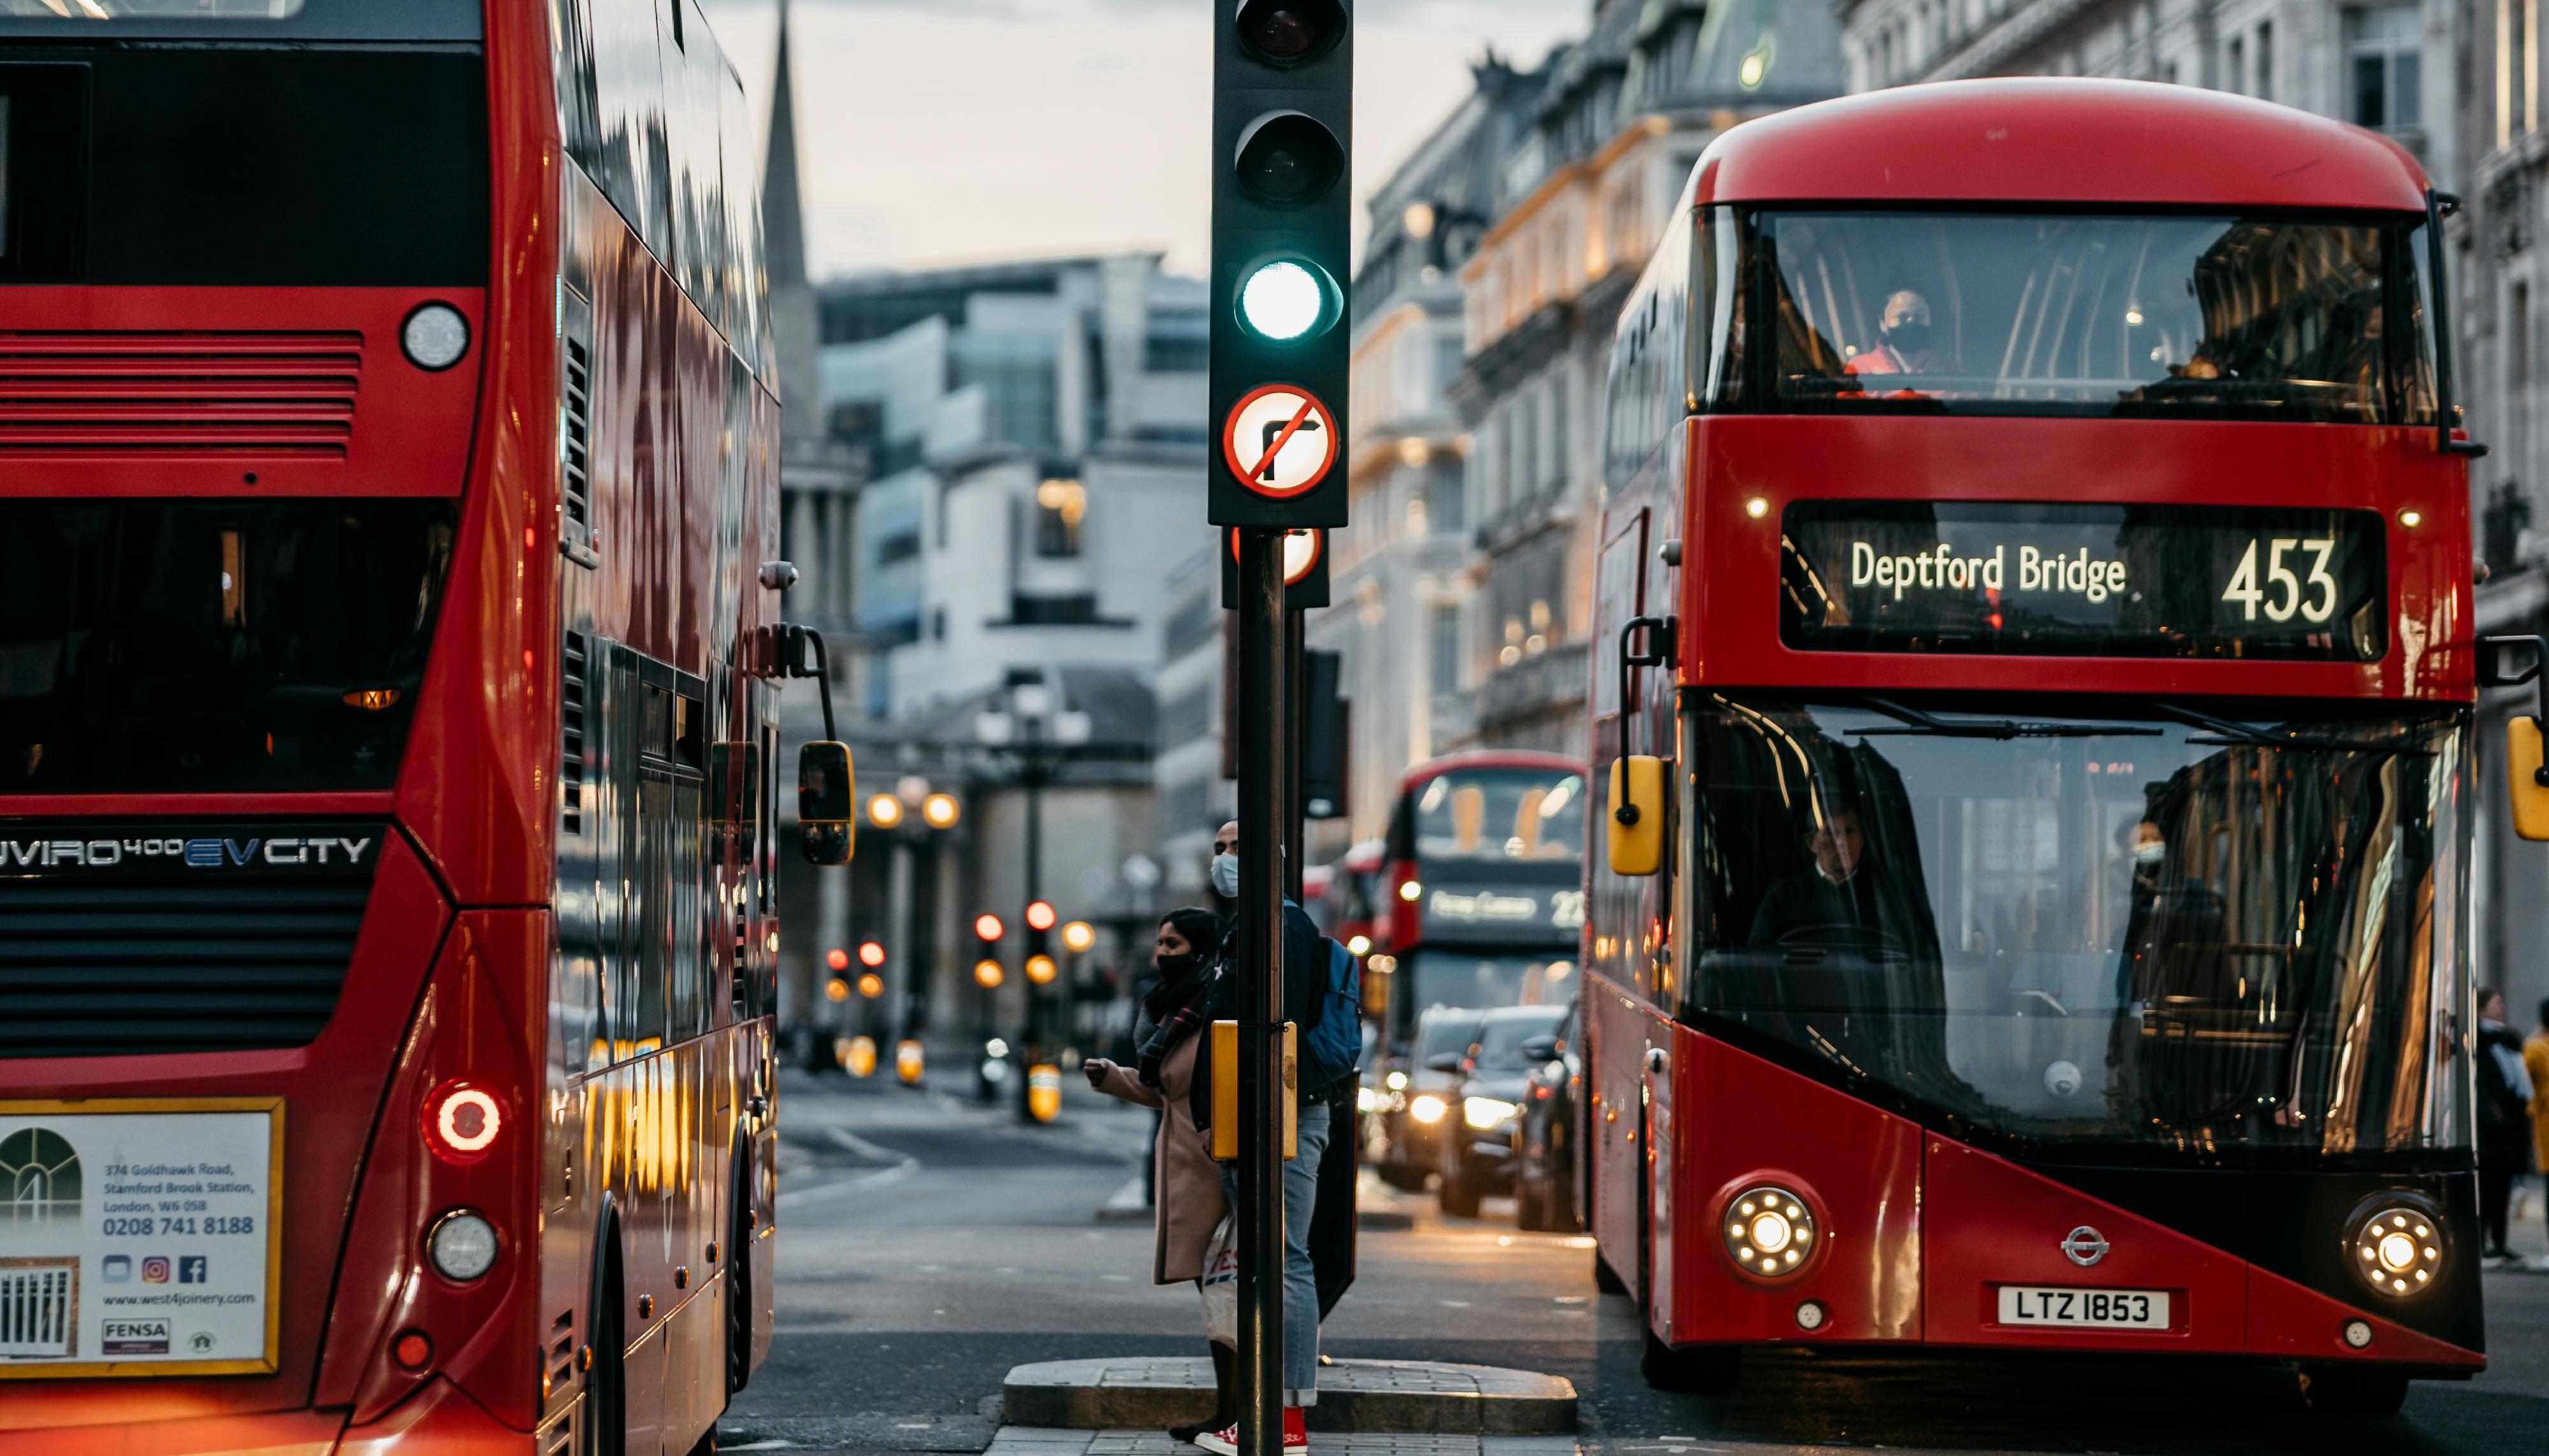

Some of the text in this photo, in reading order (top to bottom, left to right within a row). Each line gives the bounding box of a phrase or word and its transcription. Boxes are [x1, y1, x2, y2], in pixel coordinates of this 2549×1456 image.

[1852, 541, 2126, 603] Deptford Bridge
[2221, 538, 2337, 623] 453
[104, 1163, 234, 1176] 374 Goldhawk Road,
[104, 1181, 255, 1195] Stamford Brook Station,
[103, 1201, 154, 1214] London,
[158, 1200, 180, 1212] W6
[103, 1216, 254, 1236] 0208 741 8188
[103, 1293, 255, 1307] www.west4joinery.com
[2017, 1292, 2149, 1322] LTZ 1853
[106, 1323, 166, 1337] FENSA
